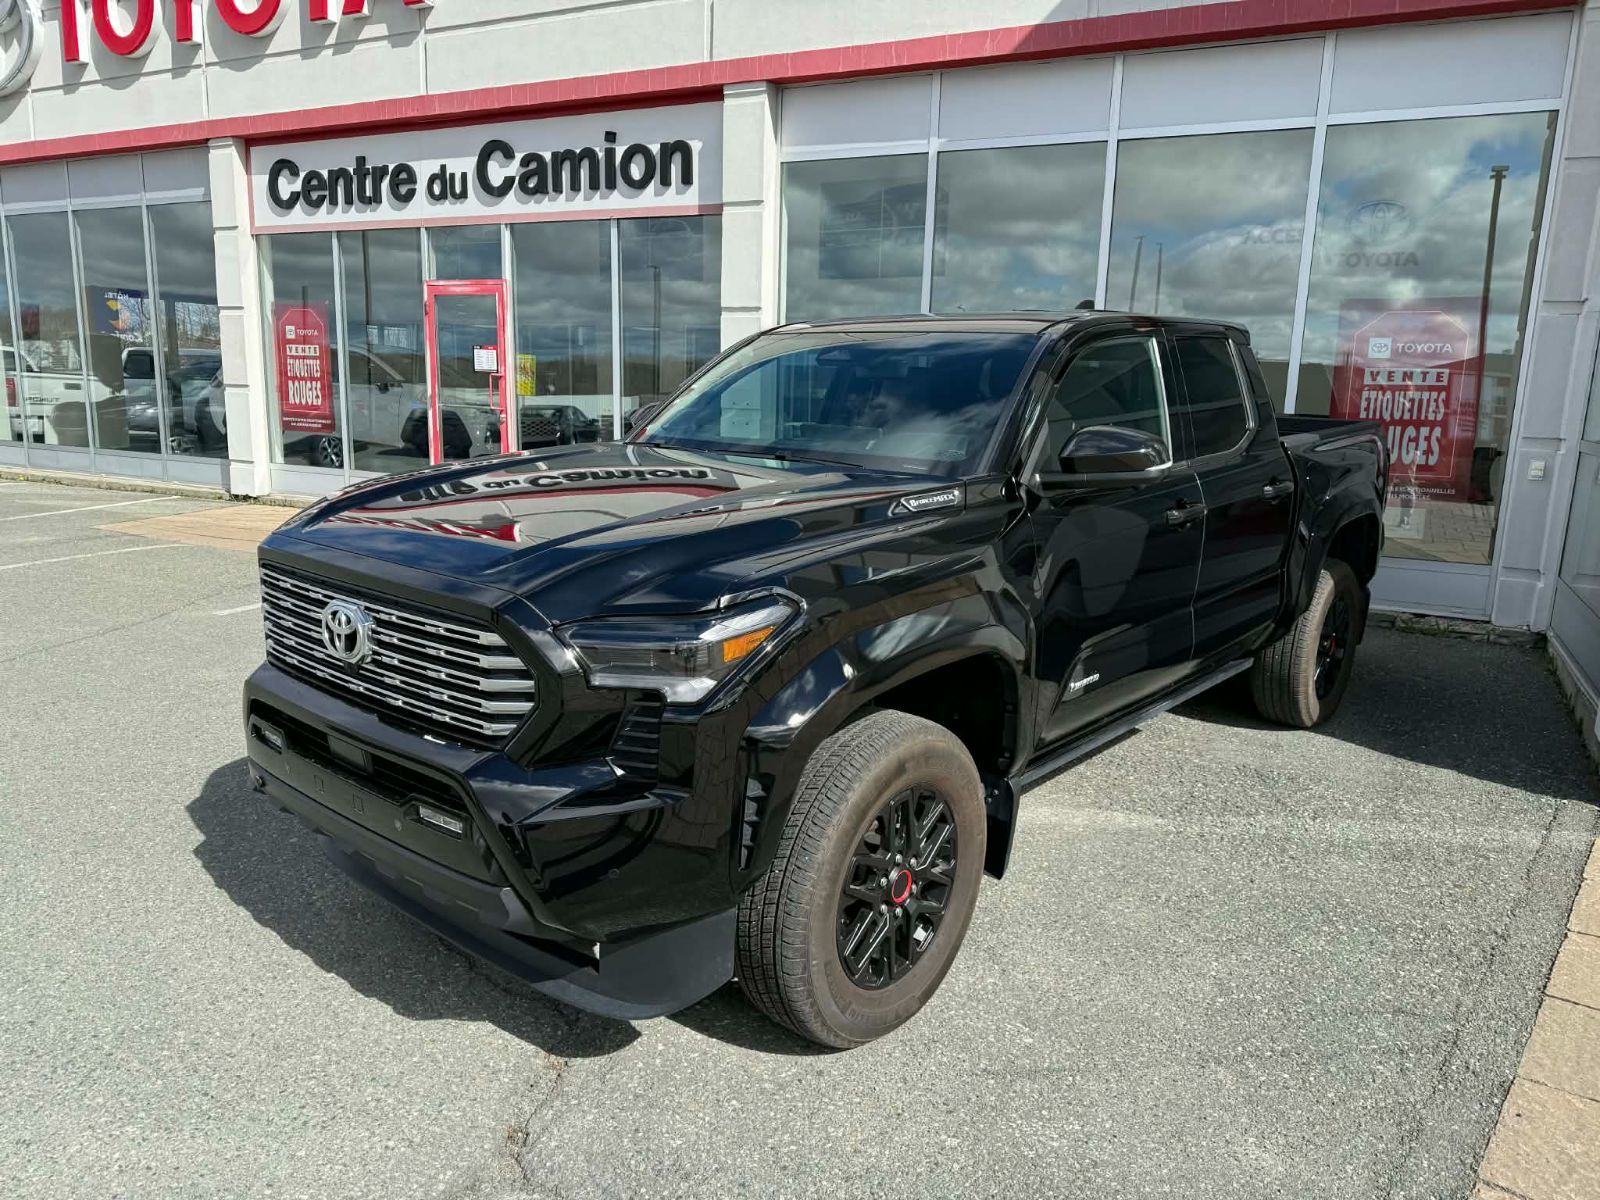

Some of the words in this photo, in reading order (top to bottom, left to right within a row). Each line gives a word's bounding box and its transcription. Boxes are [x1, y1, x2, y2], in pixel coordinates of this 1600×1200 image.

[268, 155, 417, 209] Centre
[427, 163, 469, 201] du
[475, 130, 694, 197] Camion
[288, 346, 318, 354] VENTE
[1396, 342, 1454, 353] TOYOTA
[1370, 371, 1445, 383] VENTE
[288, 380, 322, 406] ROUGES
[1360, 386, 1446, 422] ÉTIQUETTES
[1387, 426, 1442, 466] UGES
